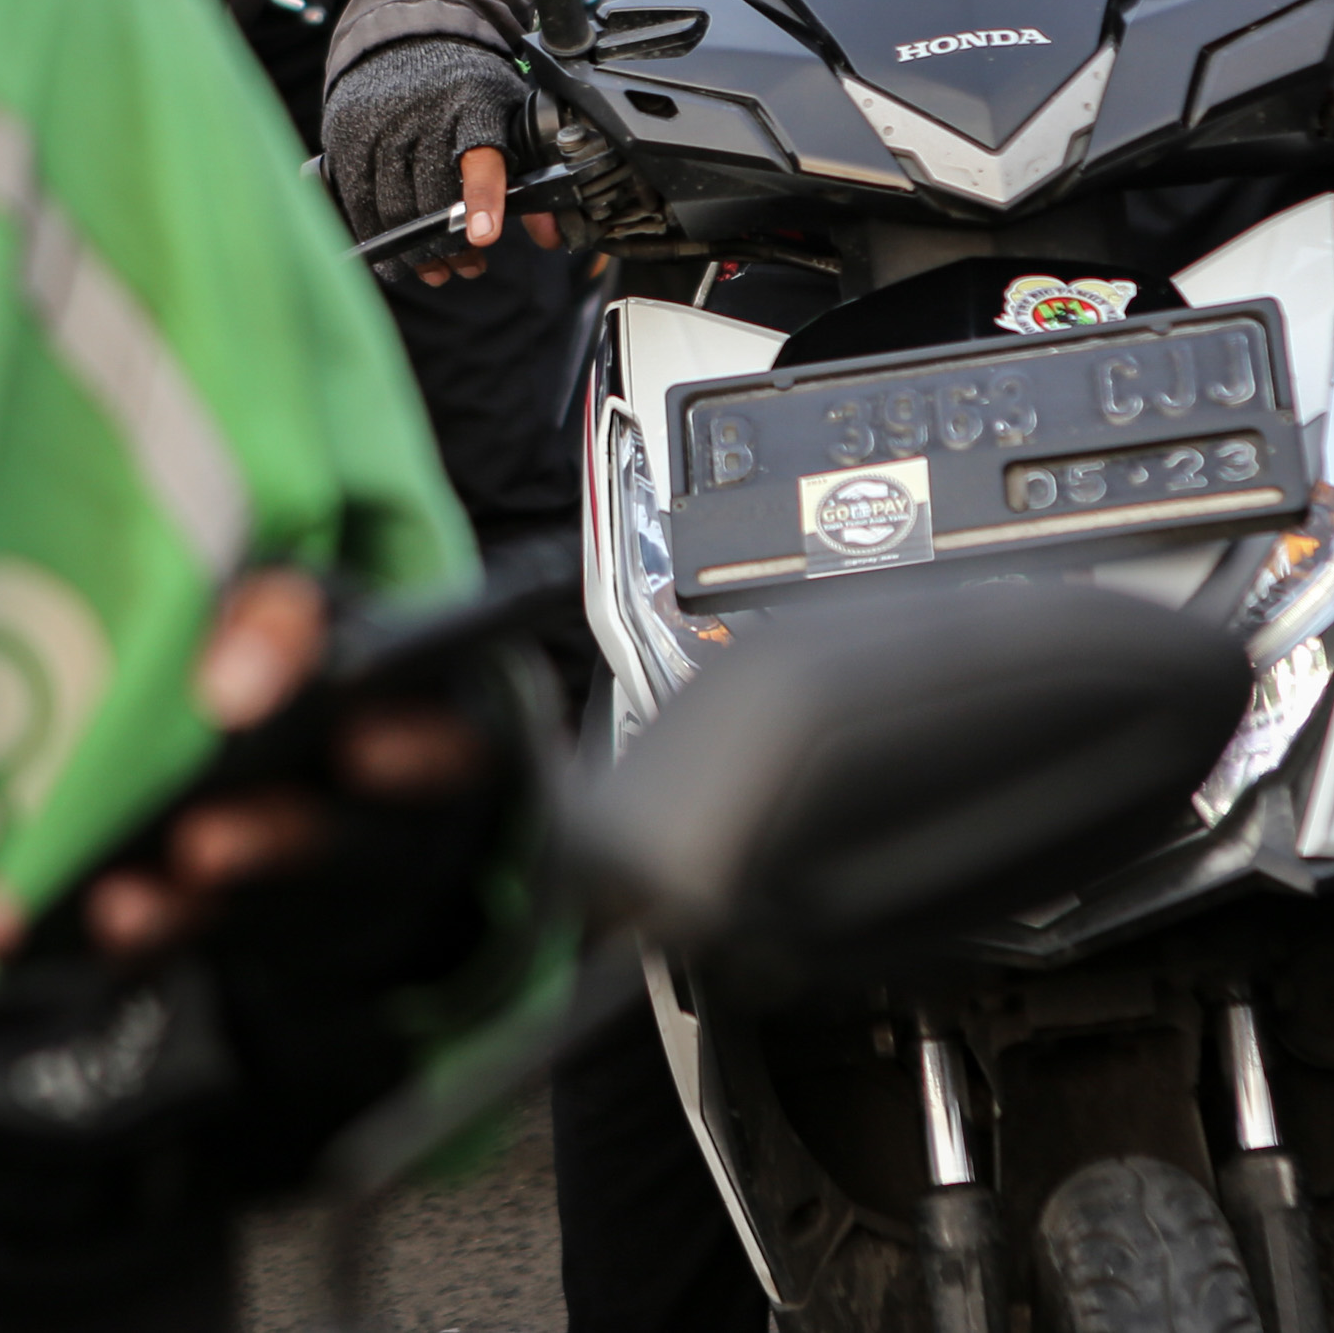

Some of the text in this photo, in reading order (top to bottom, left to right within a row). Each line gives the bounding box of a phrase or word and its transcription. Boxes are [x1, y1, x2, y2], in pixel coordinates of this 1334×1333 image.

[895, 27, 1052, 63] HONDA
[709, 414, 753, 487] B
[1096, 331, 1258, 426] CJJ
[821, 505, 849, 523] GO
[871, 497, 908, 516] PAY
